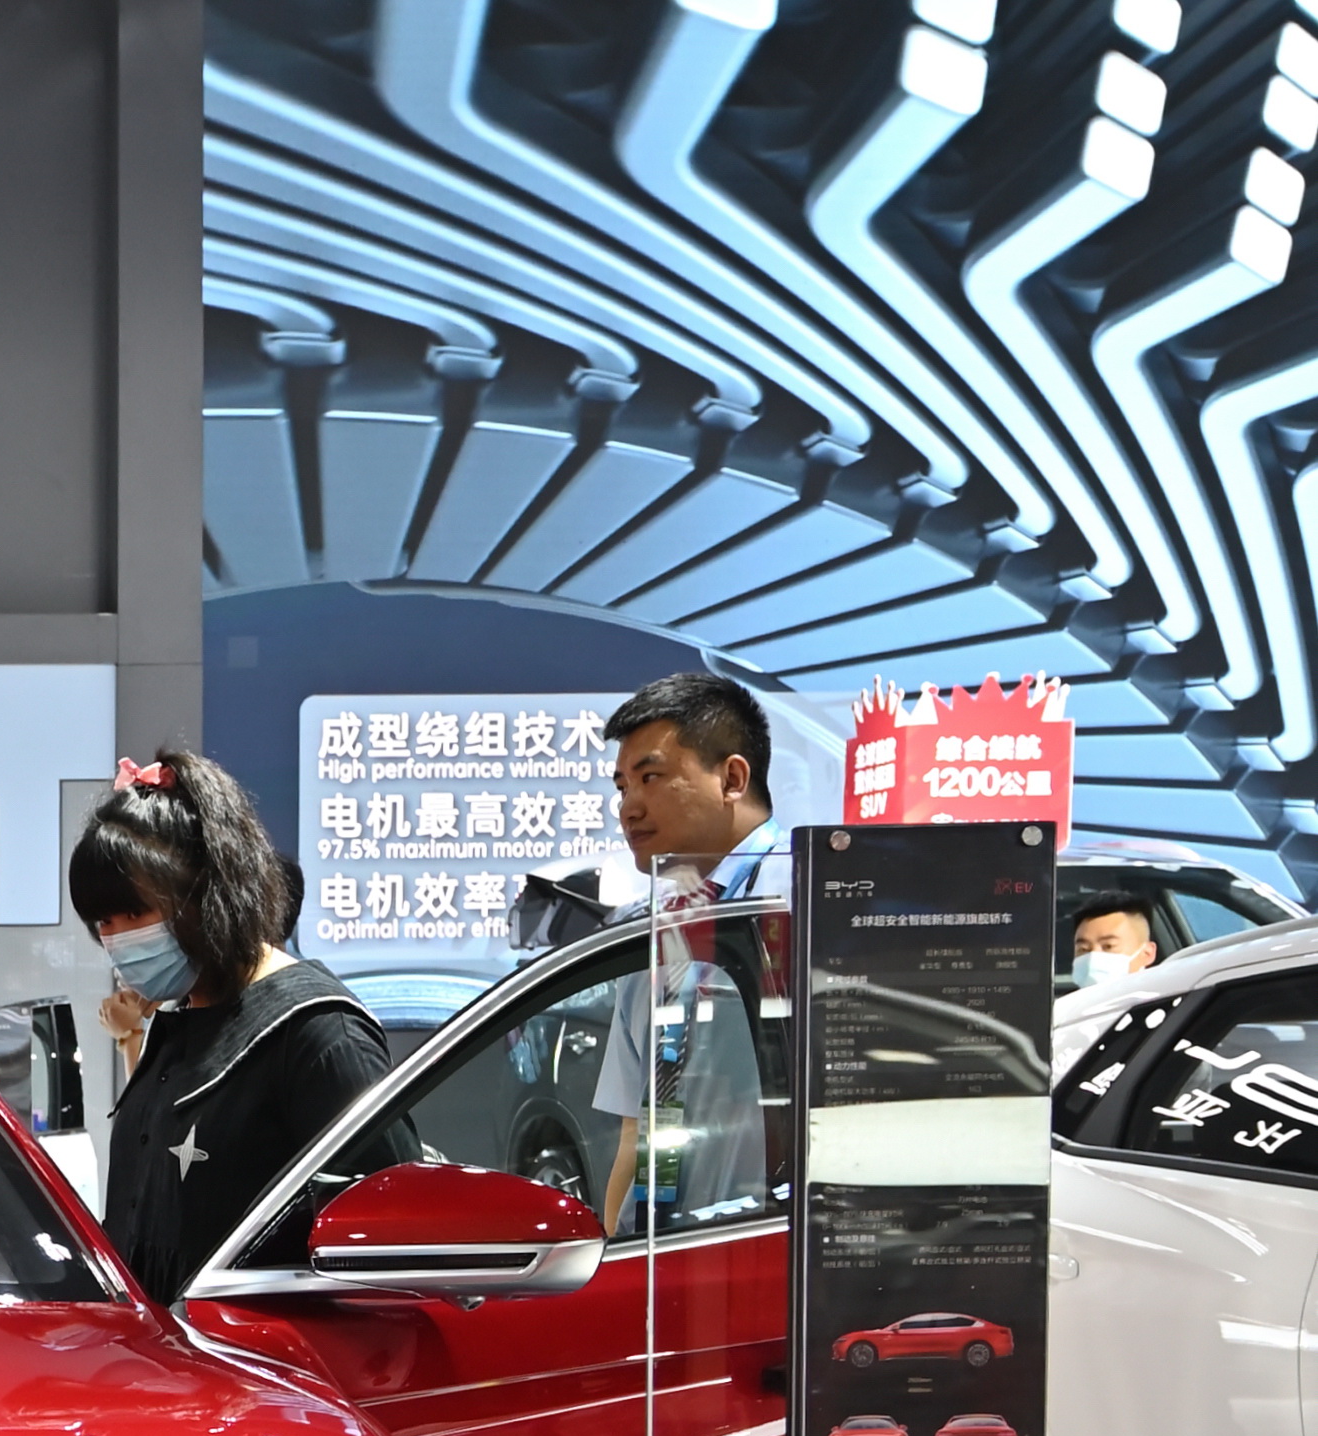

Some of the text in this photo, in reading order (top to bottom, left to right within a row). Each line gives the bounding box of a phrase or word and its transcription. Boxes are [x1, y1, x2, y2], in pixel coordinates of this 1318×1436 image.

[317, 710, 606, 759] 成型绕组技术
[318, 759, 366, 784] High
[371, 758, 504, 783] performance
[510, 759, 591, 782] winding
[922, 765, 1053, 798] 1200公里
[859, 790, 888, 819] SUV
[317, 838, 379, 860] 97.5%
[386, 838, 487, 859] maximum
[493, 840, 553, 859] motor
[824, 879, 875, 891] BYD
[1015, 881, 1034, 894] EV
[317, 918, 398, 943] Optimal
[405, 920, 466, 938] motor
